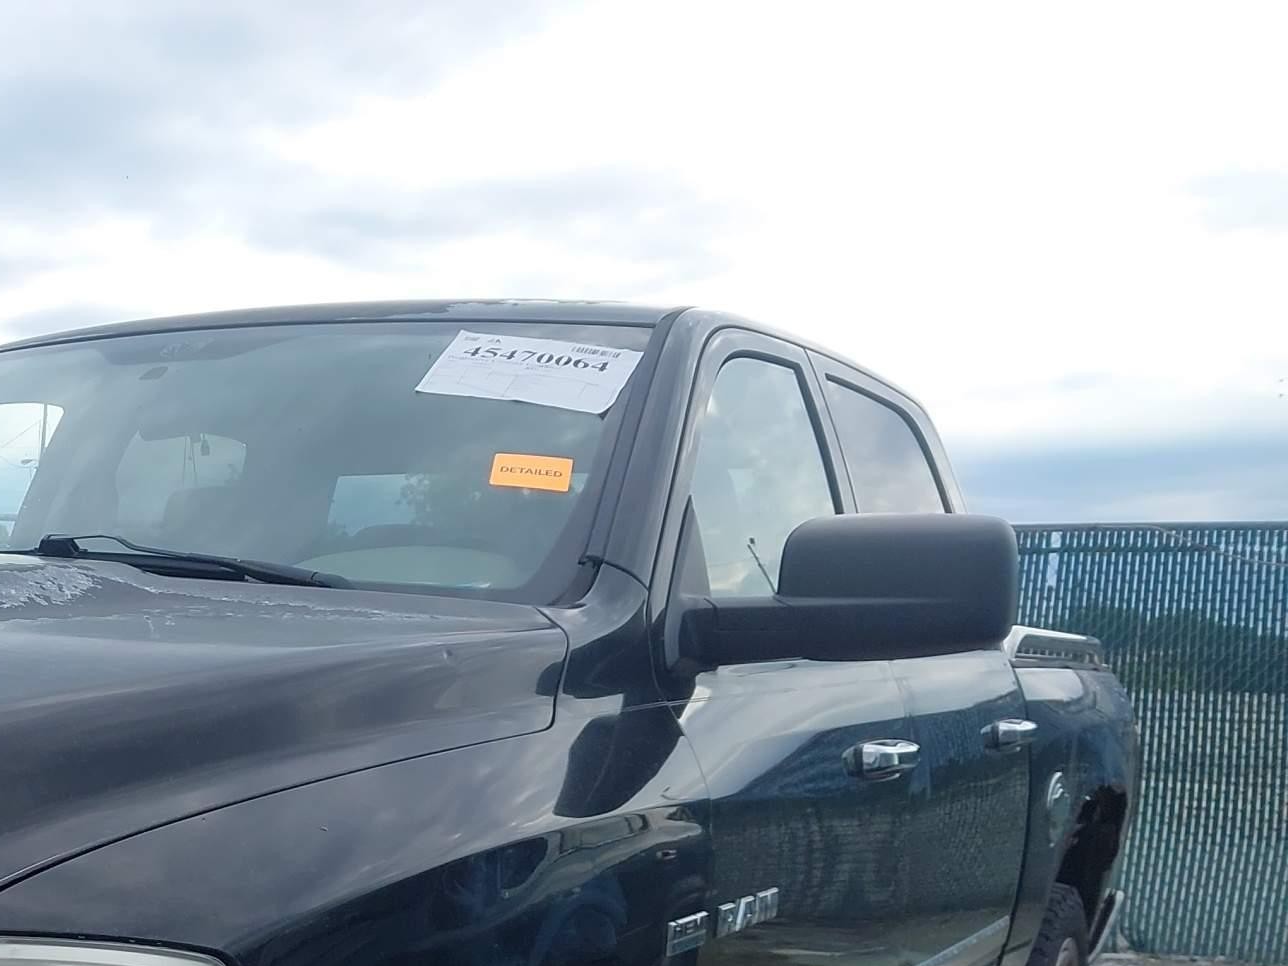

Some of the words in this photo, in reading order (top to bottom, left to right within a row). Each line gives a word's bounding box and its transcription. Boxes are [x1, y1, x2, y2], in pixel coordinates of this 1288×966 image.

[463, 346, 609, 372] 45470064
[499, 465, 563, 478] DETAILED
[716, 887, 779, 939] RAM
